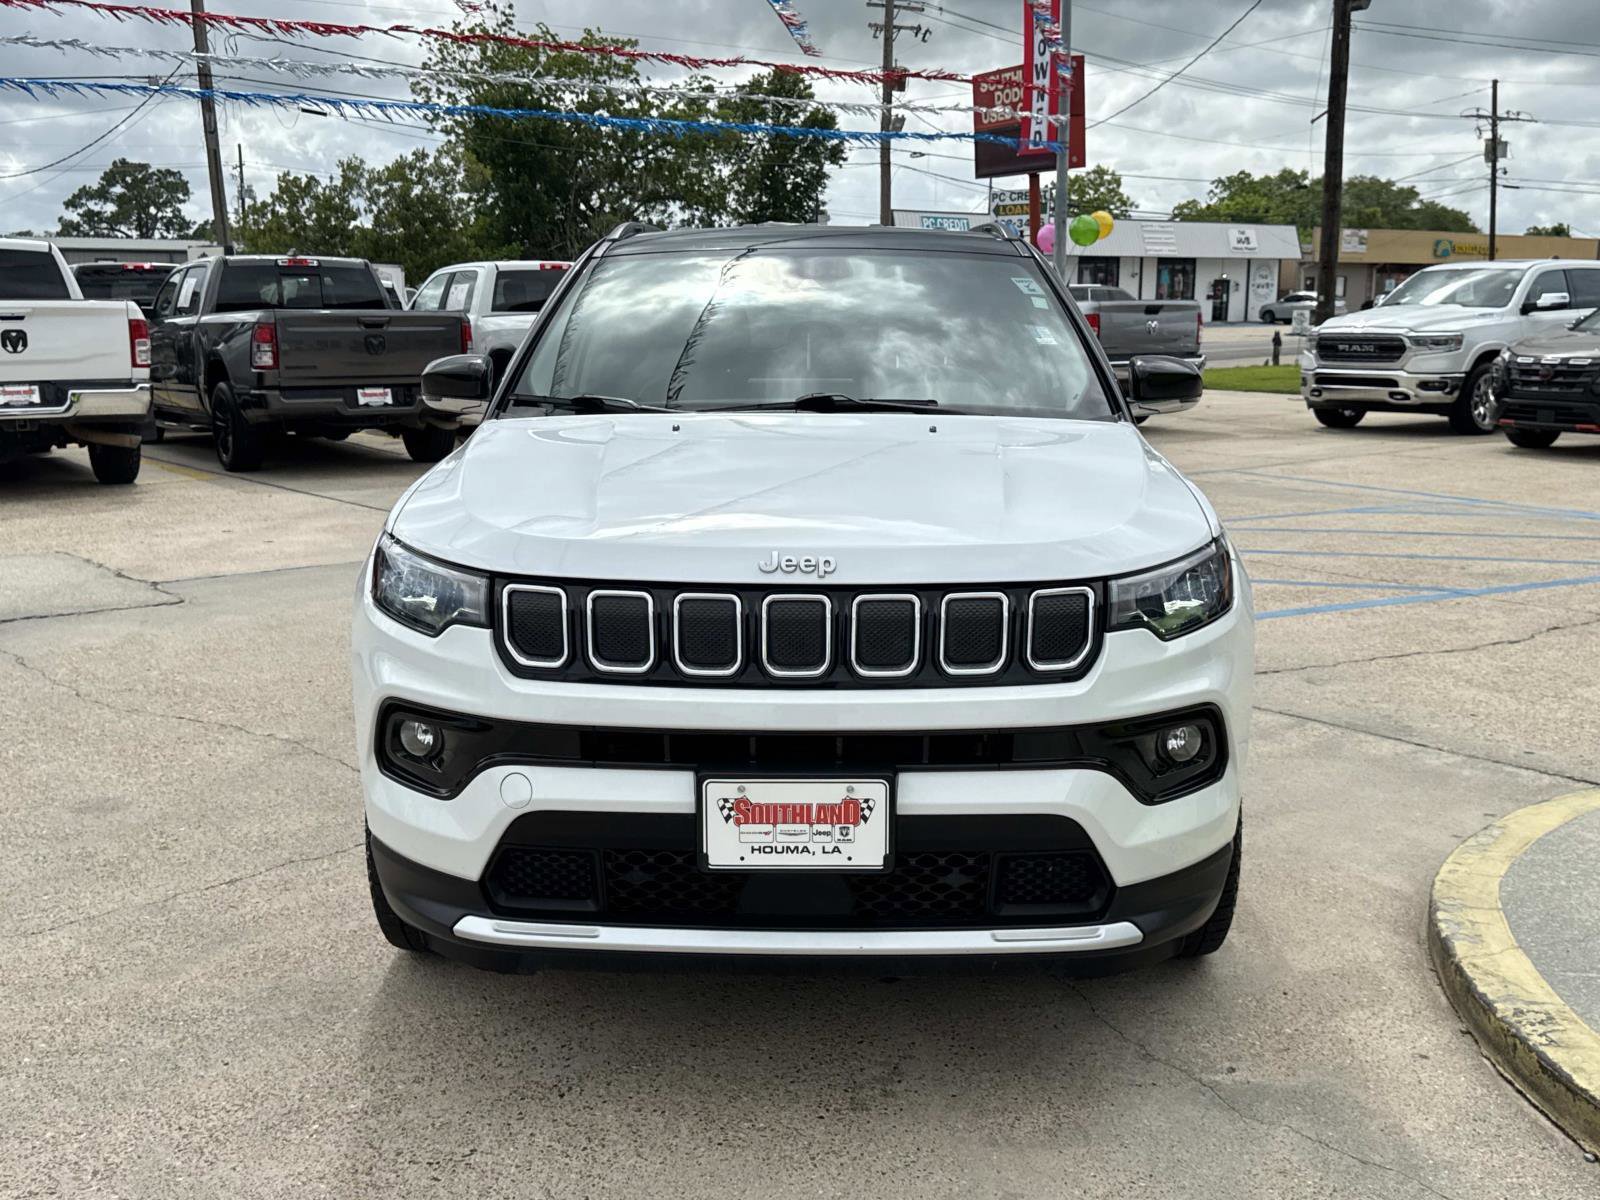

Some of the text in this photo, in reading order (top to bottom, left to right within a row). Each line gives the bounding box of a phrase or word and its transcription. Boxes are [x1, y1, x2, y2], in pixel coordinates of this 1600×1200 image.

[995, 88, 1024, 106] DOD
[992, 189, 1048, 203] PC CRET
[999, 204, 1033, 216] LOAN
[922, 217, 935, 230] PC
[759, 550, 837, 579] Jeep
[733, 799, 862, 826] SOUTHLAND
[812, 829, 832, 838] Jeep
[751, 845, 842, 856] HOUMA, LA
